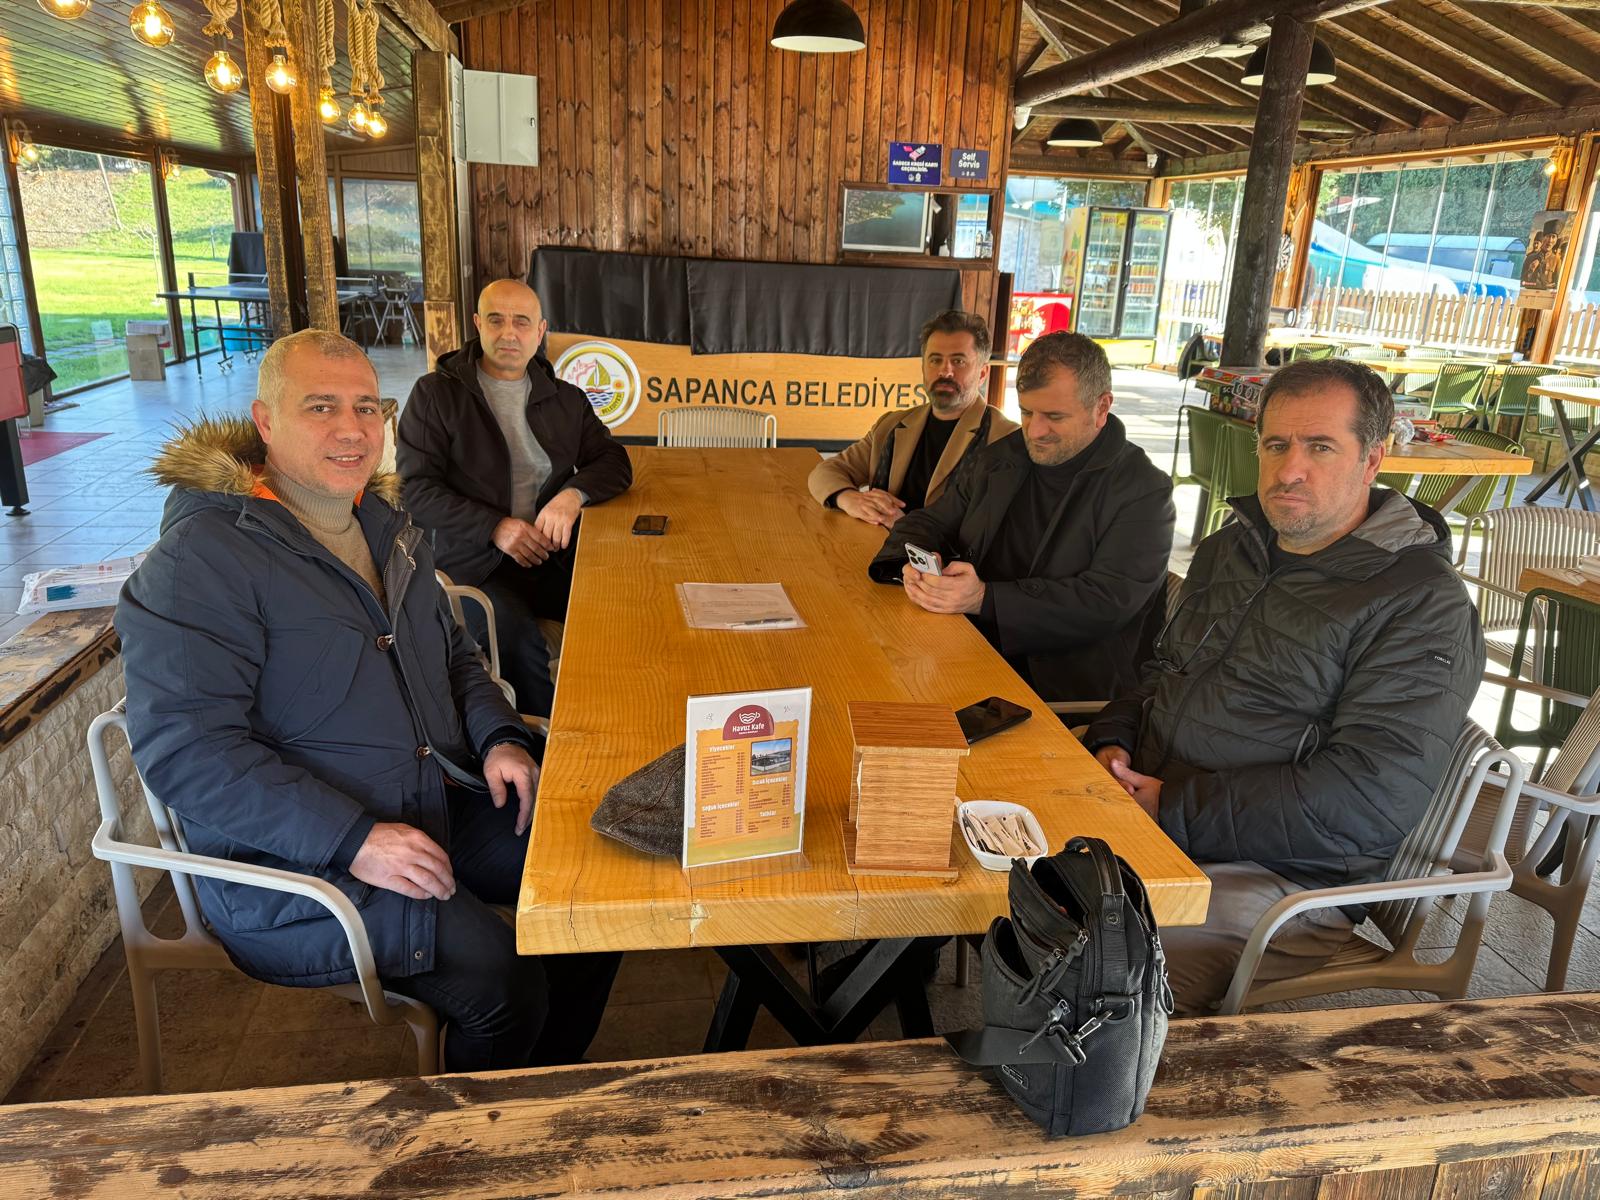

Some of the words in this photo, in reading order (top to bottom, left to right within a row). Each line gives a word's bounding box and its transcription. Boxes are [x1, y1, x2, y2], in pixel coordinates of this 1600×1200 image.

[962, 152, 976, 161] Self
[958, 160, 980, 169] Servis
[646, 376, 777, 406] SAPANCA
[785, 376, 927, 408] BELEDİYES
[732, 725, 750, 733] Havuz
[751, 722, 765, 731] Kafe
